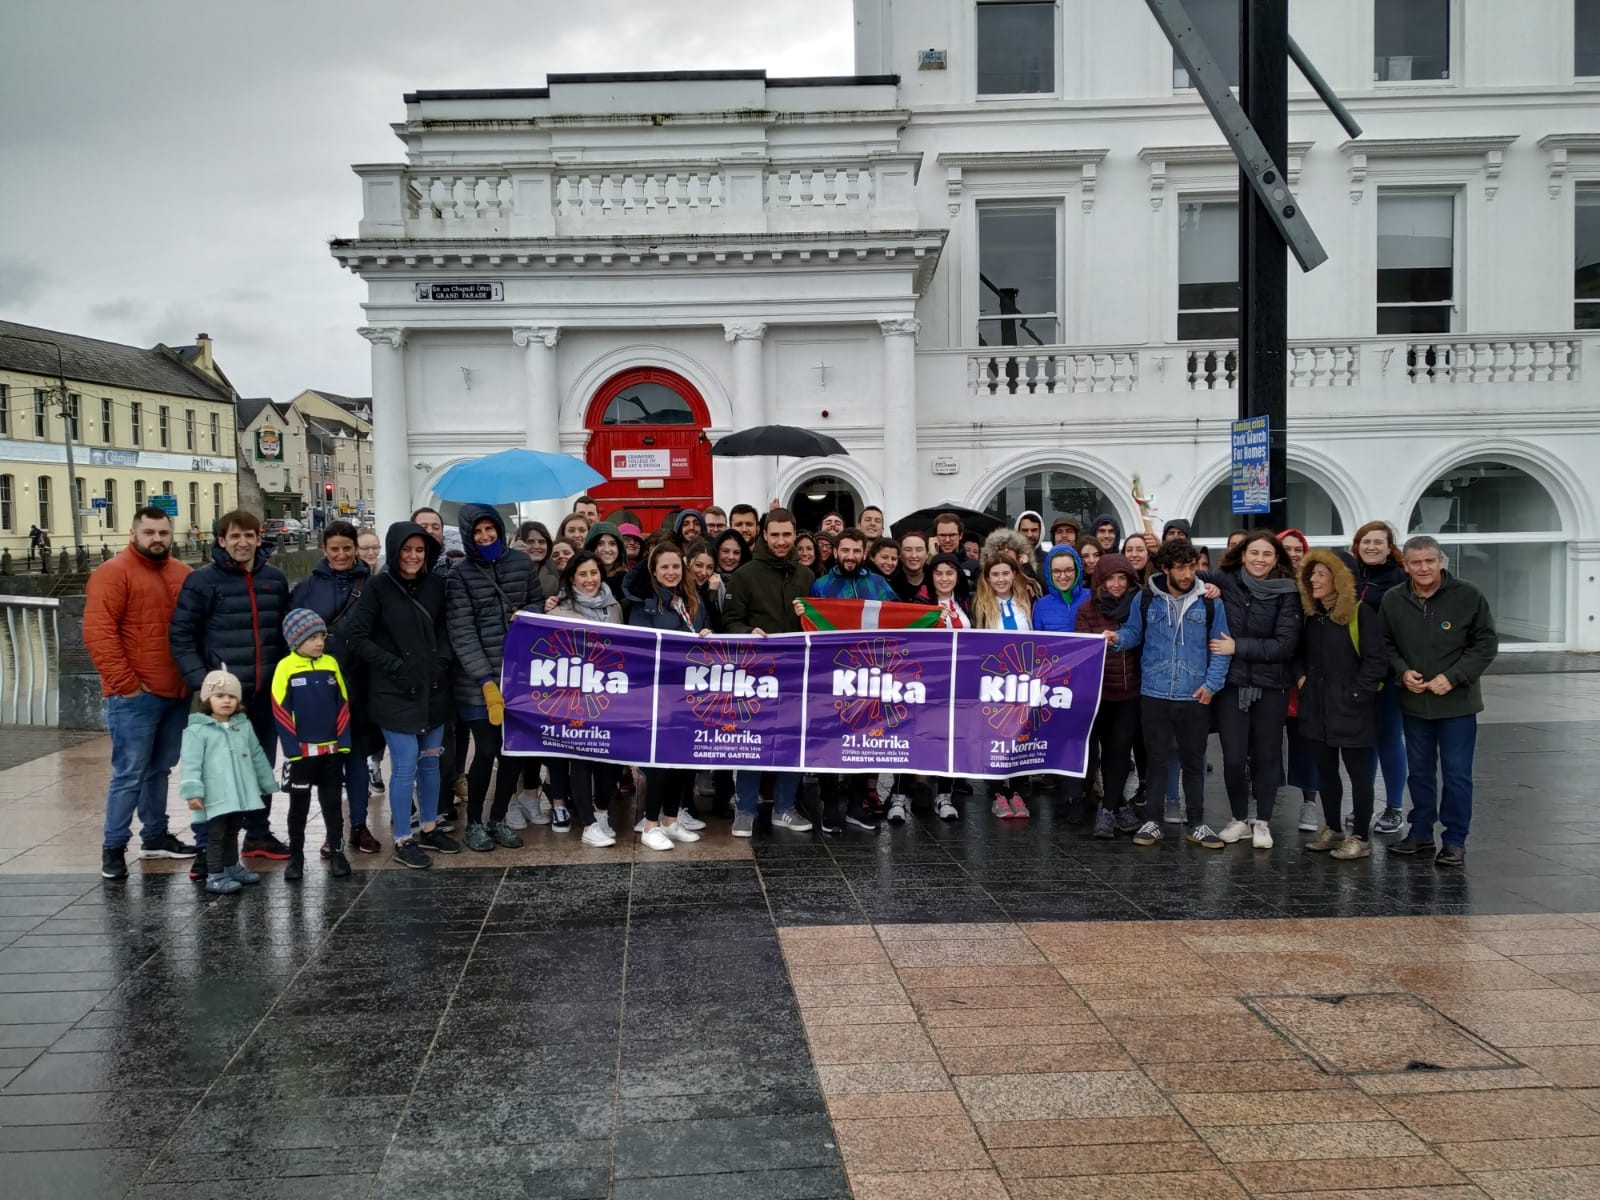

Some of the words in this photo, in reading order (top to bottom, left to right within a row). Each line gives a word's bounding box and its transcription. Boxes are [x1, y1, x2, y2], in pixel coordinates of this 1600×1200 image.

[1247, 430, 1267, 445] March
[1233, 447, 1243, 461] For
[1243, 445, 1266, 460] Homes
[529, 657, 629, 694] Klika
[683, 663, 779, 698] Klika
[832, 667, 926, 704] Klika
[979, 673, 1073, 709] Klika
[540, 724, 560, 738] 21.
[561, 724, 611, 740] korrika
[694, 729, 713, 743] 21.
[714, 728, 762, 744] korrika
[842, 734, 861, 748] 21.
[862, 733, 910, 749] korrika
[990, 740, 1010, 754] 21.
[1011, 737, 1048, 754] korrika
[575, 745, 610, 754] GASTEIZA
[727, 751, 761, 759] GASTEIZA
